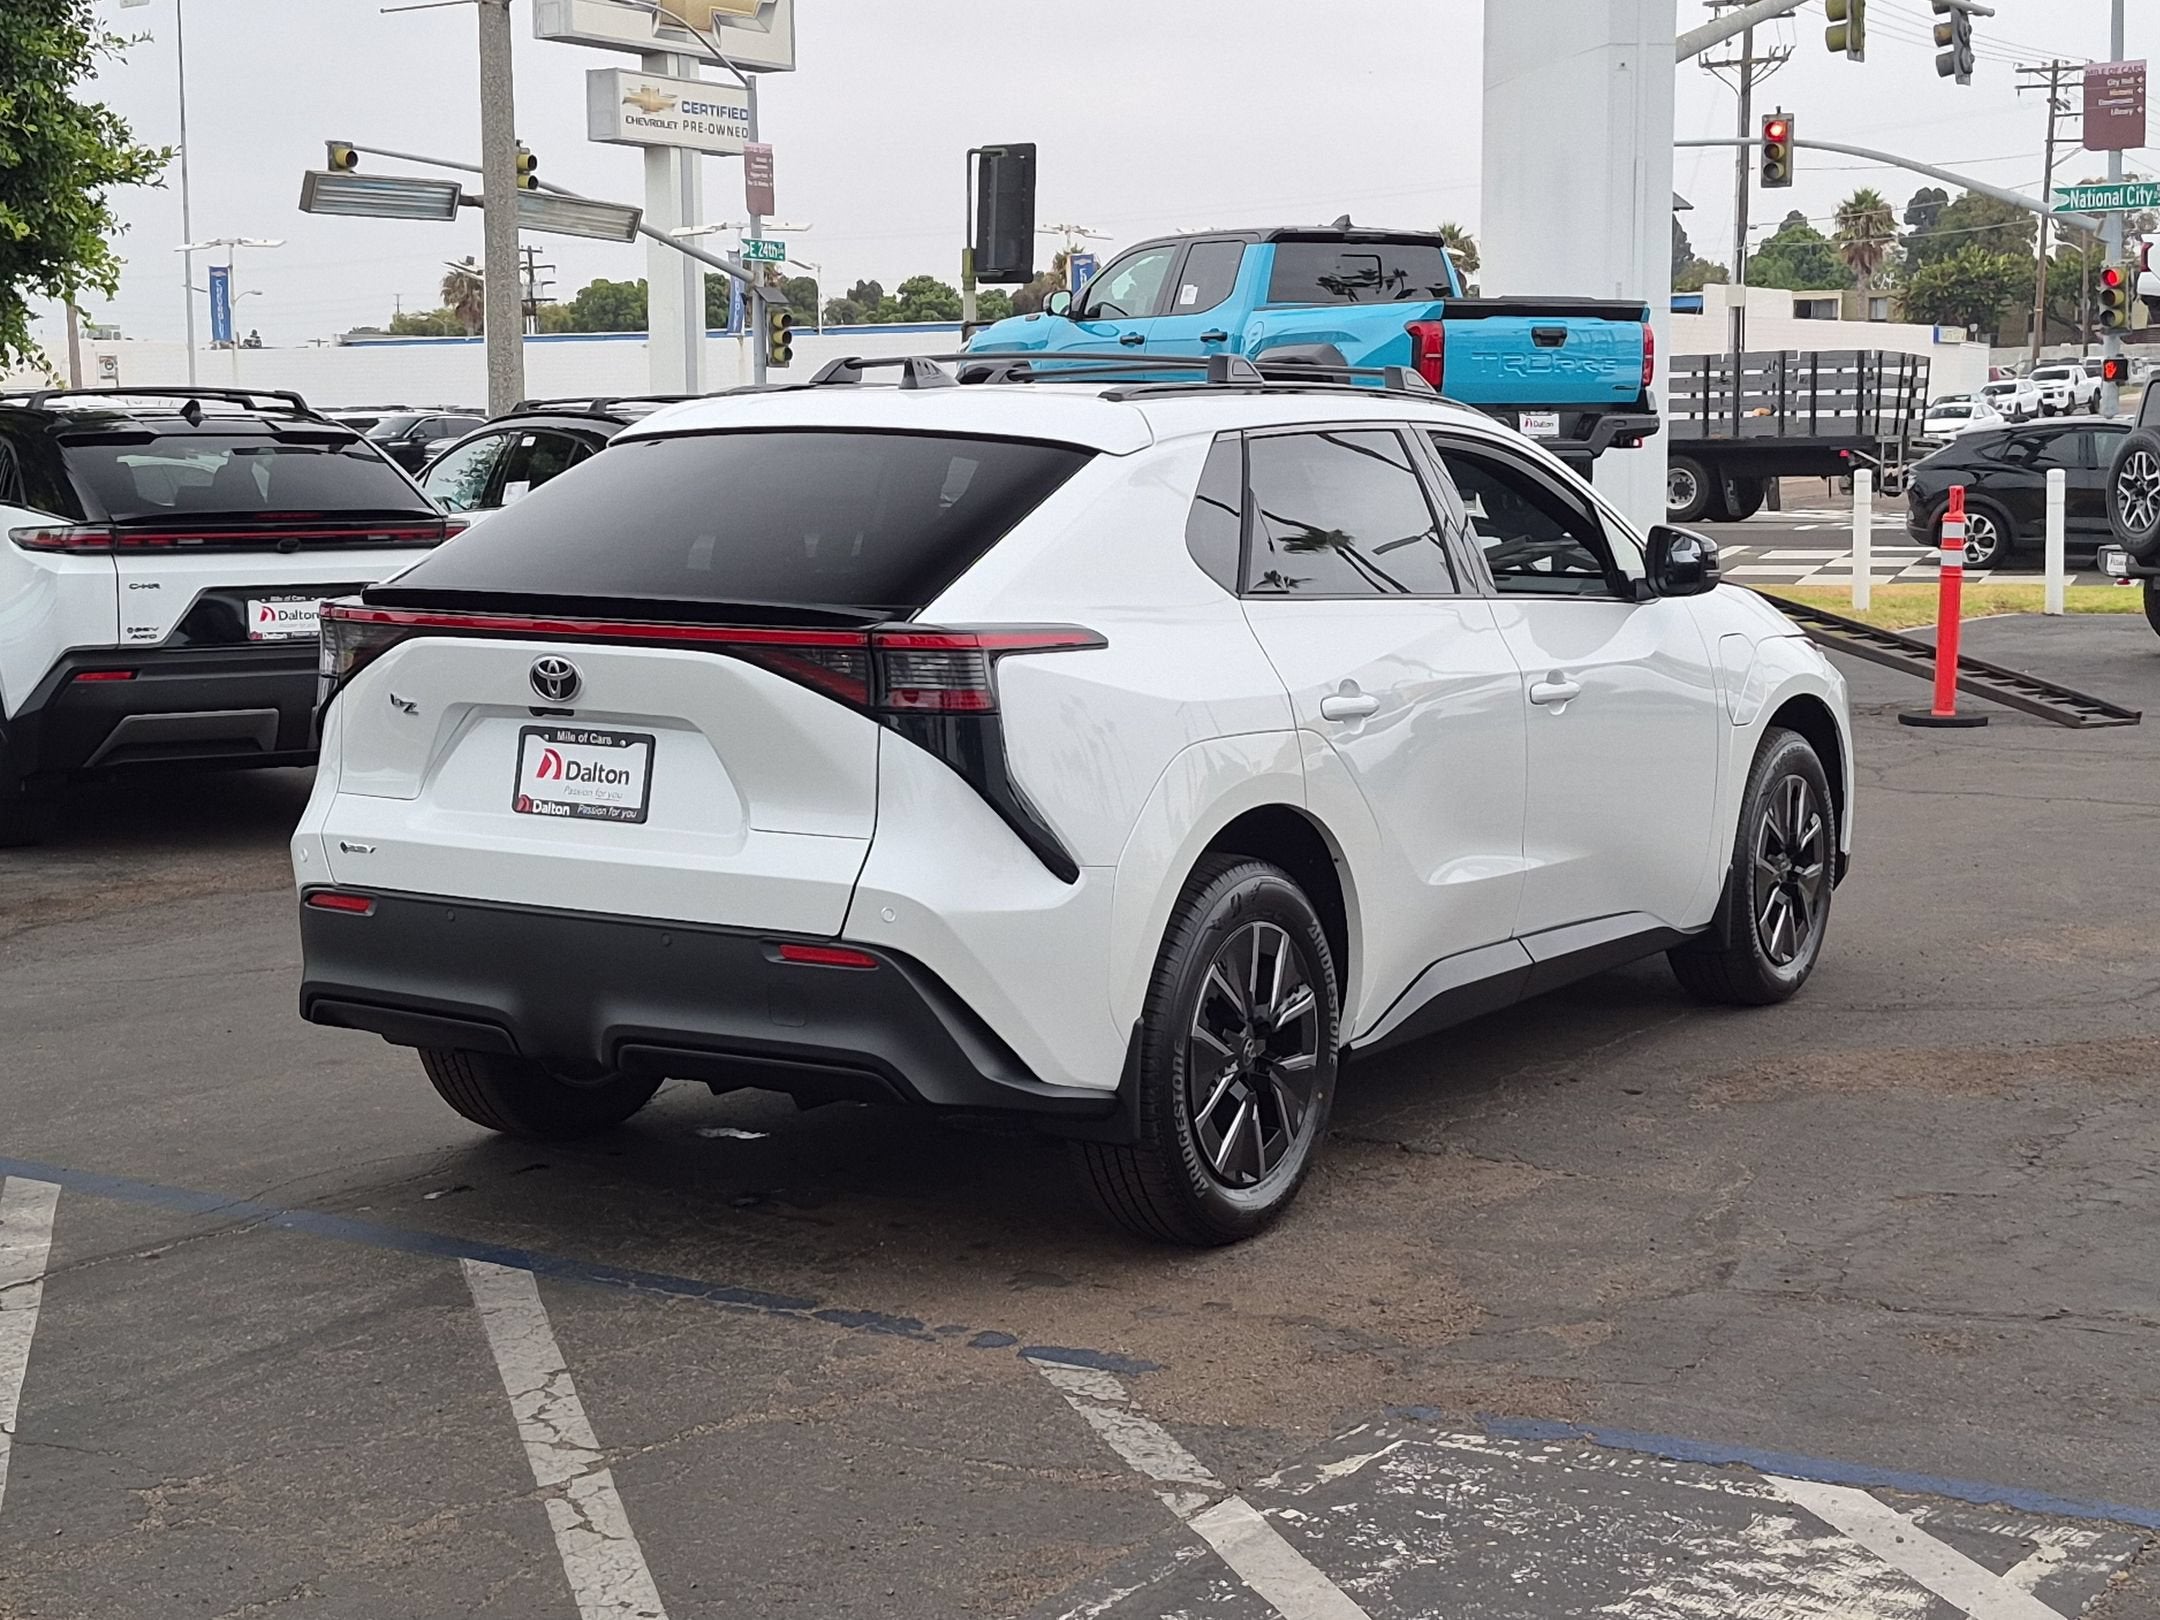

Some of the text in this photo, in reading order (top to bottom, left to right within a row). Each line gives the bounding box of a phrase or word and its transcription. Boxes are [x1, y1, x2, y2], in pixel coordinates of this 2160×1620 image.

[681, 101, 748, 121] CERTIFIED
[625, 115, 748, 138] CHEVROLET PRE-OWNED
[2070, 187, 2124, 208] National
[2126, 186, 2153, 205] City
[749, 241, 757, 257] E
[758, 242, 778, 258] 24th
[1472, 352, 1552, 378] TRD
[278, 609, 320, 621] Dalton
[557, 731, 612, 745] Mile of Cars
[565, 760, 630, 785] Dalton
[595, 787, 607, 799] for
[607, 790, 623, 800] you
[532, 800, 637, 819] Dalton Passion for you
[1307, 922, 1340, 1067] BRIDGESTONE
[1172, 1038, 1209, 1198] BRIDGESTONE
